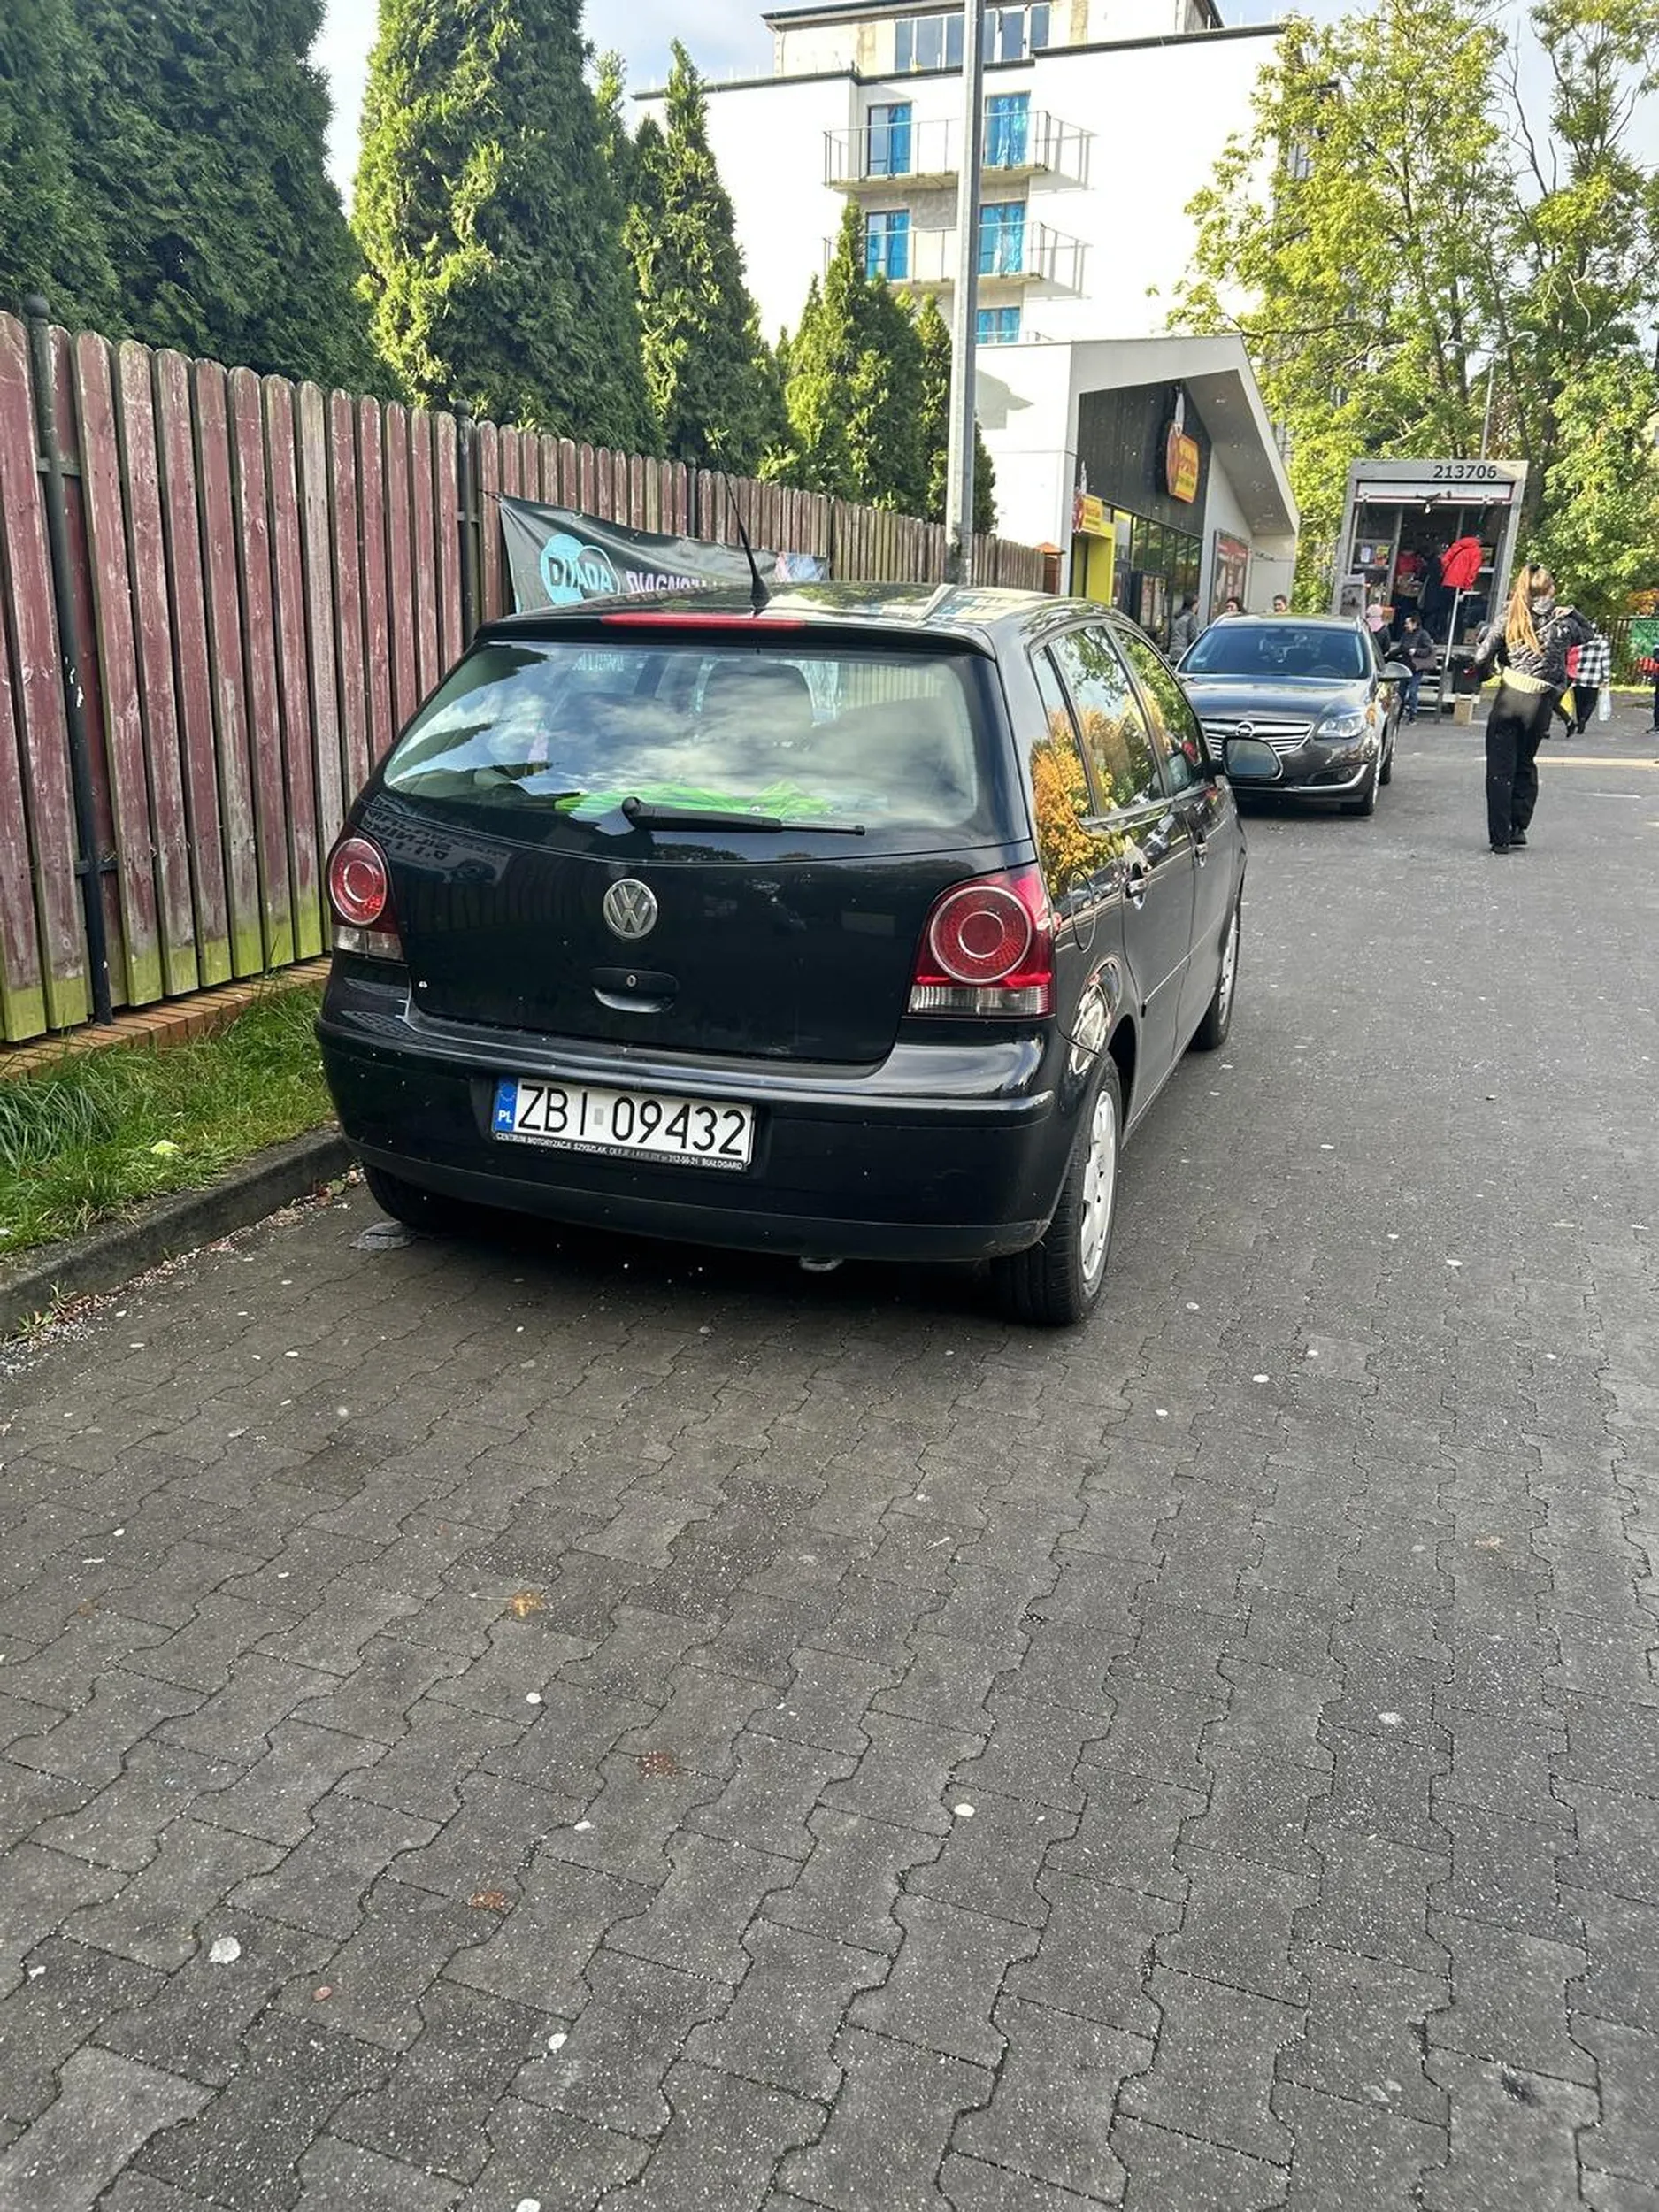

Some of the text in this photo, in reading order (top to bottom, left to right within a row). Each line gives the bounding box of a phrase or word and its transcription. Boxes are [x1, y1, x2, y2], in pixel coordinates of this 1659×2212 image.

[1433, 465, 1497, 479] 213706
[548, 557, 615, 592] DIADA
[497, 1110, 513, 1125] PL
[518, 1084, 746, 1156] ZBI 09432
